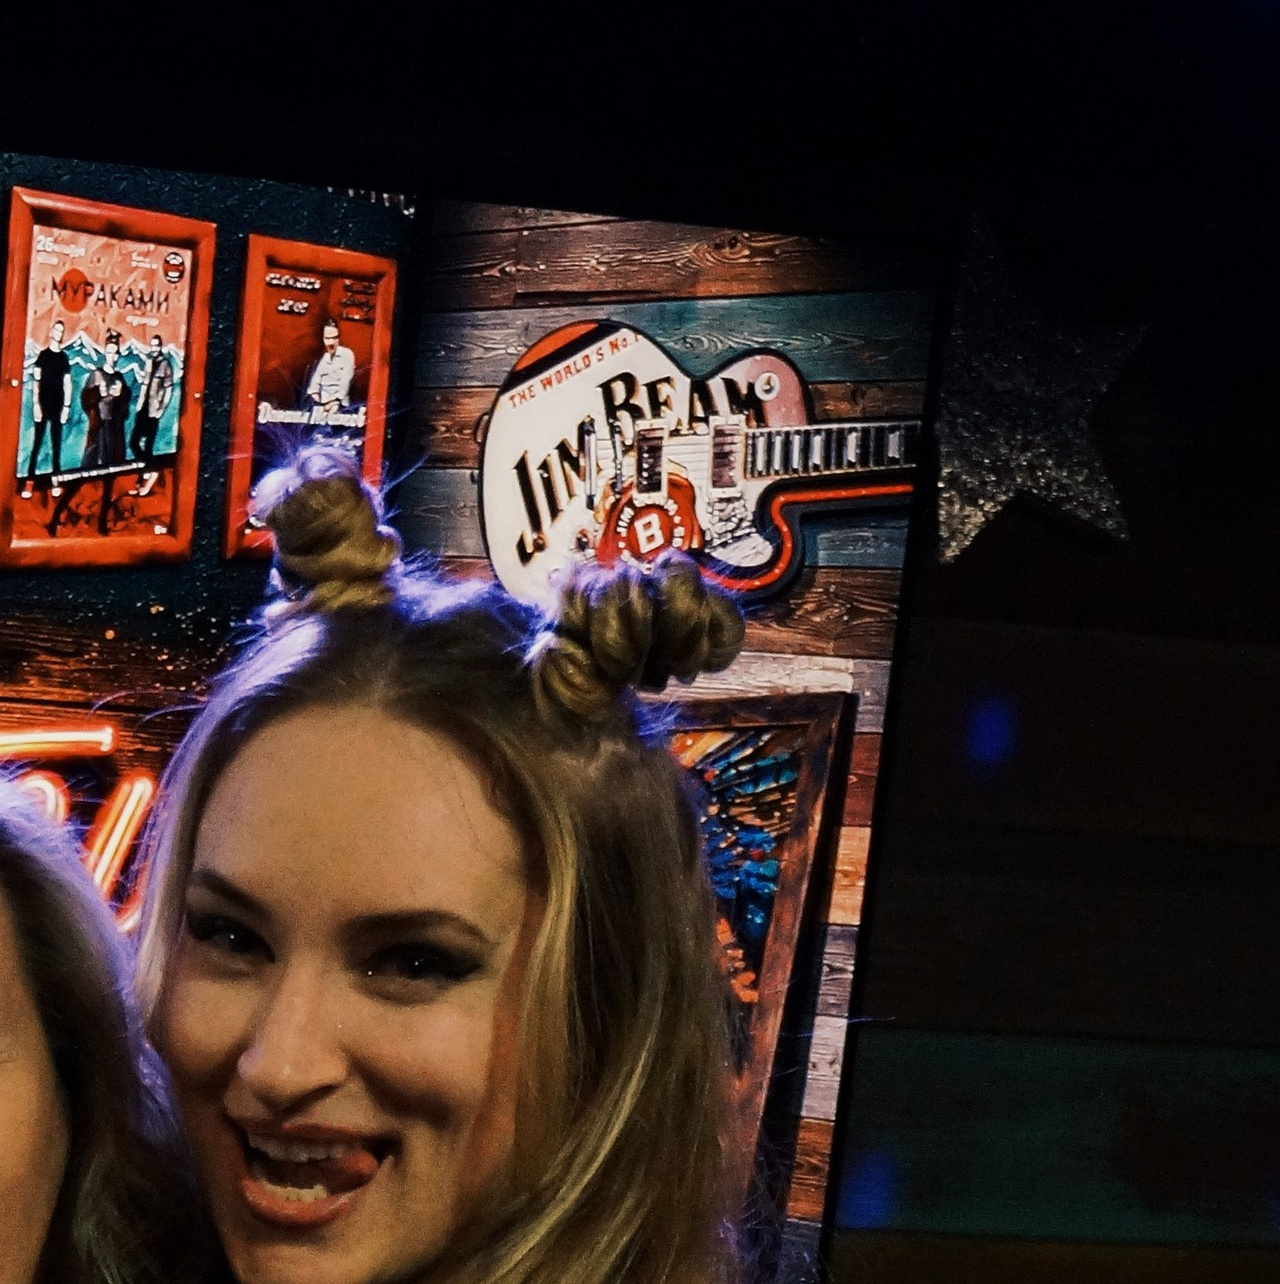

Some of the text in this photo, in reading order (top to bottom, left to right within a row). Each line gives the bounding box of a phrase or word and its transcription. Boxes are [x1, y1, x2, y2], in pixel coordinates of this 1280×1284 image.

[50, 275, 170, 315] МУРАКАМИ
[508, 384, 536, 408] THE
[634, 513, 665, 554] B
